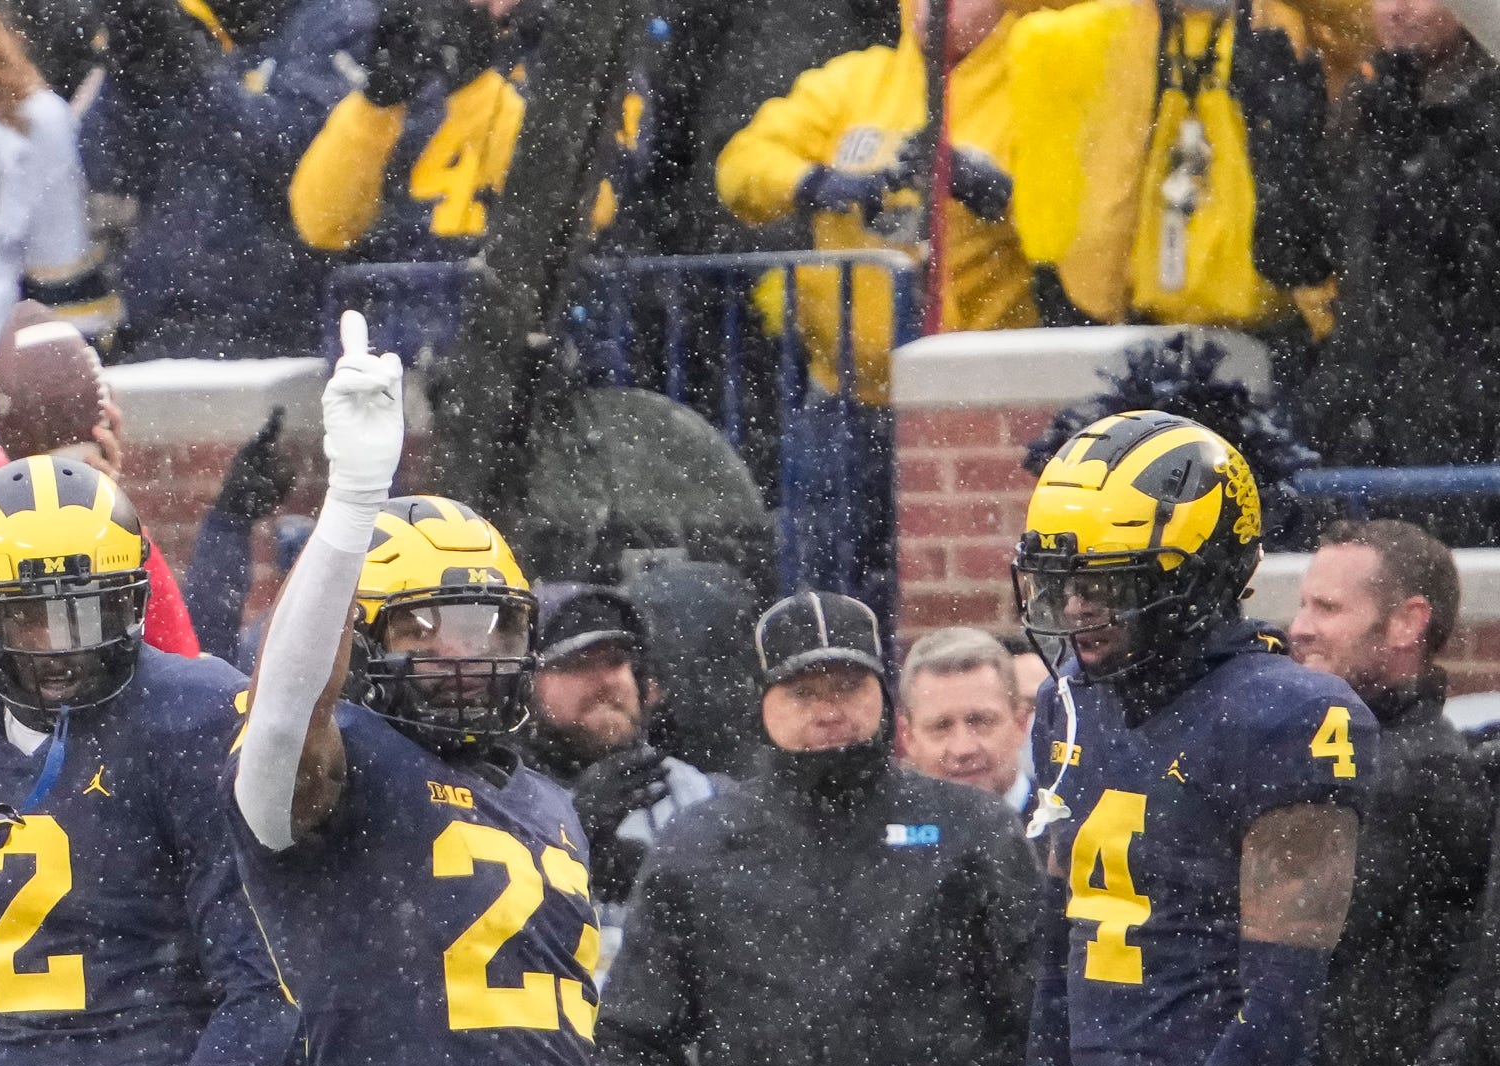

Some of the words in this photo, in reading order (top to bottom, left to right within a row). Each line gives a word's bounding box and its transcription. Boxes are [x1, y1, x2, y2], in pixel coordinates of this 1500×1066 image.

[1040, 534, 1057, 549] M
[43, 556, 66, 573] M
[467, 567, 488, 583] M
[1310, 706, 1357, 778] 4
[1066, 788, 1152, 985] 4
